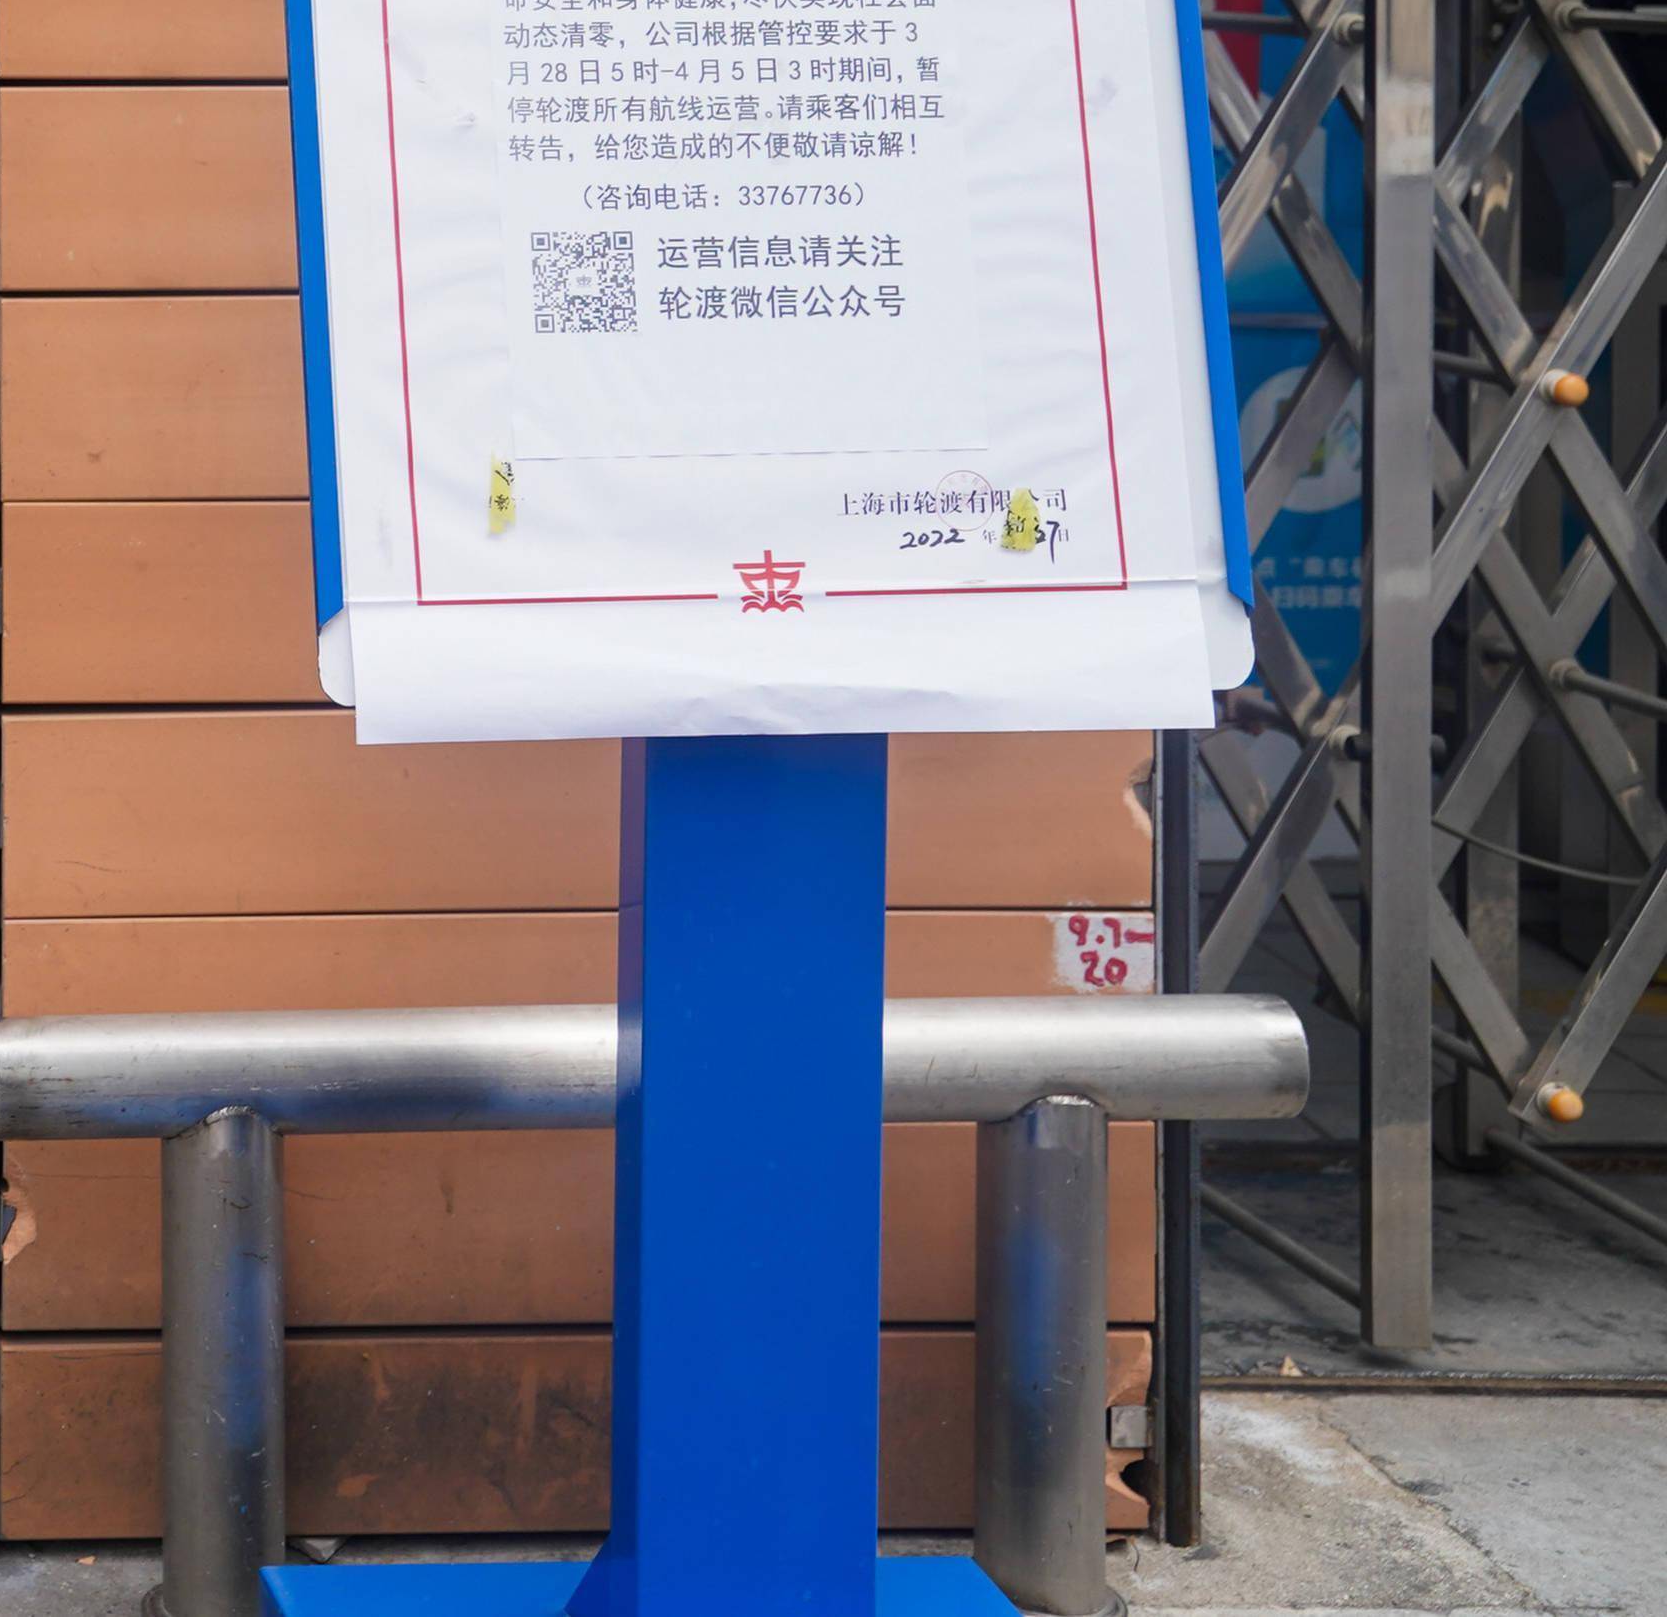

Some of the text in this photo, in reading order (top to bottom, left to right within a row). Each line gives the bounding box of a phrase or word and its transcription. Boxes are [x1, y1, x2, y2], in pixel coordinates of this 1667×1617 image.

[656, 233, 905, 270] 运营信息请关注
[658, 284, 907, 321] 轮渡微信公众号
[837, 487, 1068, 516] 上海市轮渡有限司
